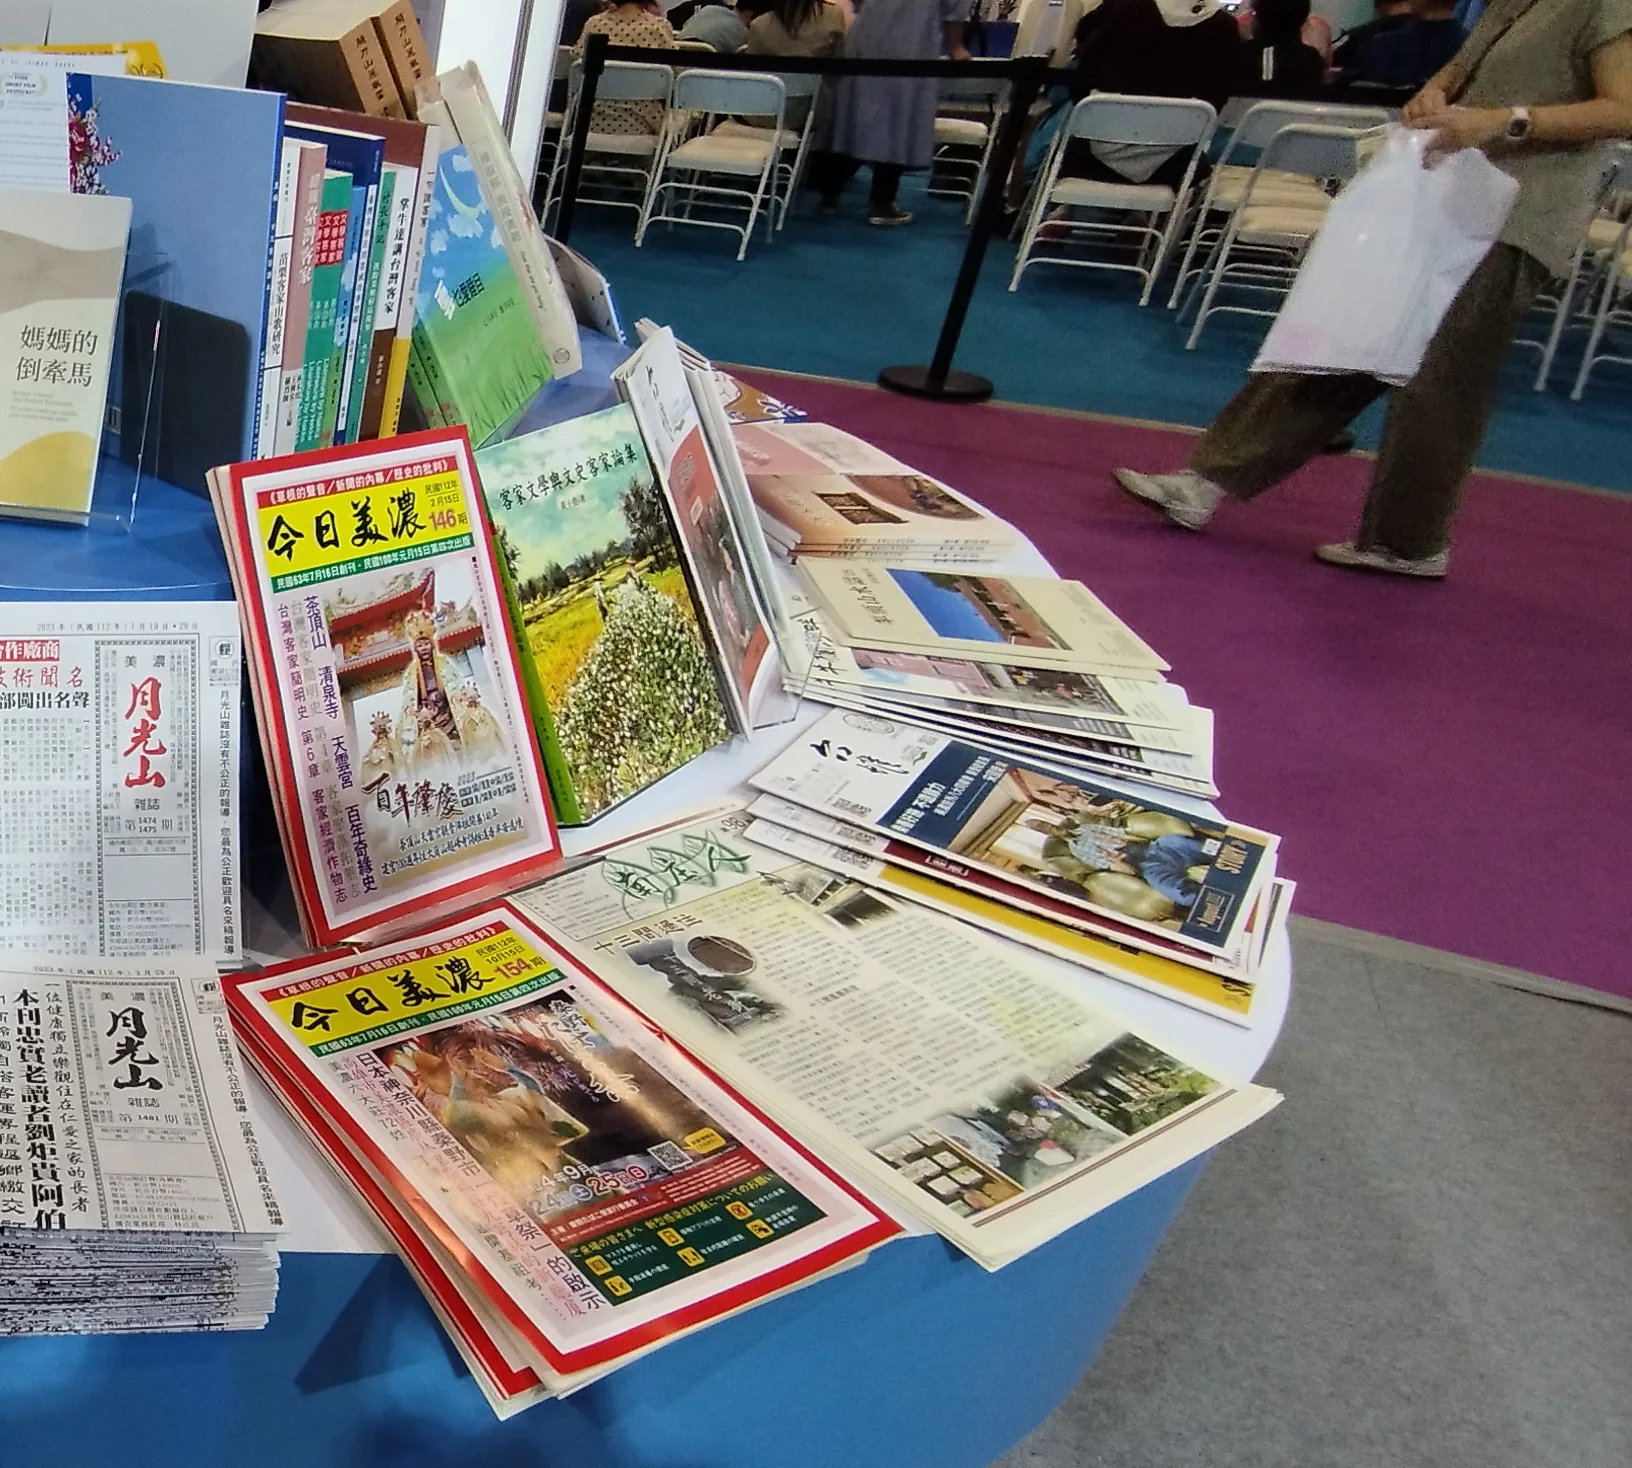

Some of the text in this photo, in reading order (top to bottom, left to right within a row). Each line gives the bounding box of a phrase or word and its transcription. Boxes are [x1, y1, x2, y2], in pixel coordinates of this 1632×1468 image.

[20, 325, 99, 356] 媽媽的
[16, 357, 93, 388] 倒牽馬
[424, 480, 458, 495] 民國112年
[499, 443, 638, 511] 客家文學與文史客家論集
[430, 493, 460, 508] 2月15日
[267, 487, 427, 561] 今日美濃
[124, 654, 166, 669] 美濃
[278, 603, 309, 721] 台灣客家簡明史
[300, 730, 321, 779] 第6章
[123, 676, 168, 789] 月光山
[304, 595, 378, 894] 茶頂山 清泉寺 天雲宮 百年奇緣史
[135, 797, 161, 812] 雜誌
[361, 772, 464, 828] 百年肇慶
[138, 816, 157, 825] 1474
[138, 825, 158, 834] 1475
[475, 936, 517, 957] 民國112年
[485, 945, 526, 965] 10月15日
[290, 955, 496, 1033] 今日美濃
[106, 1006, 163, 1091] 月光山
[127, 1097, 161, 1109] 雜誌
